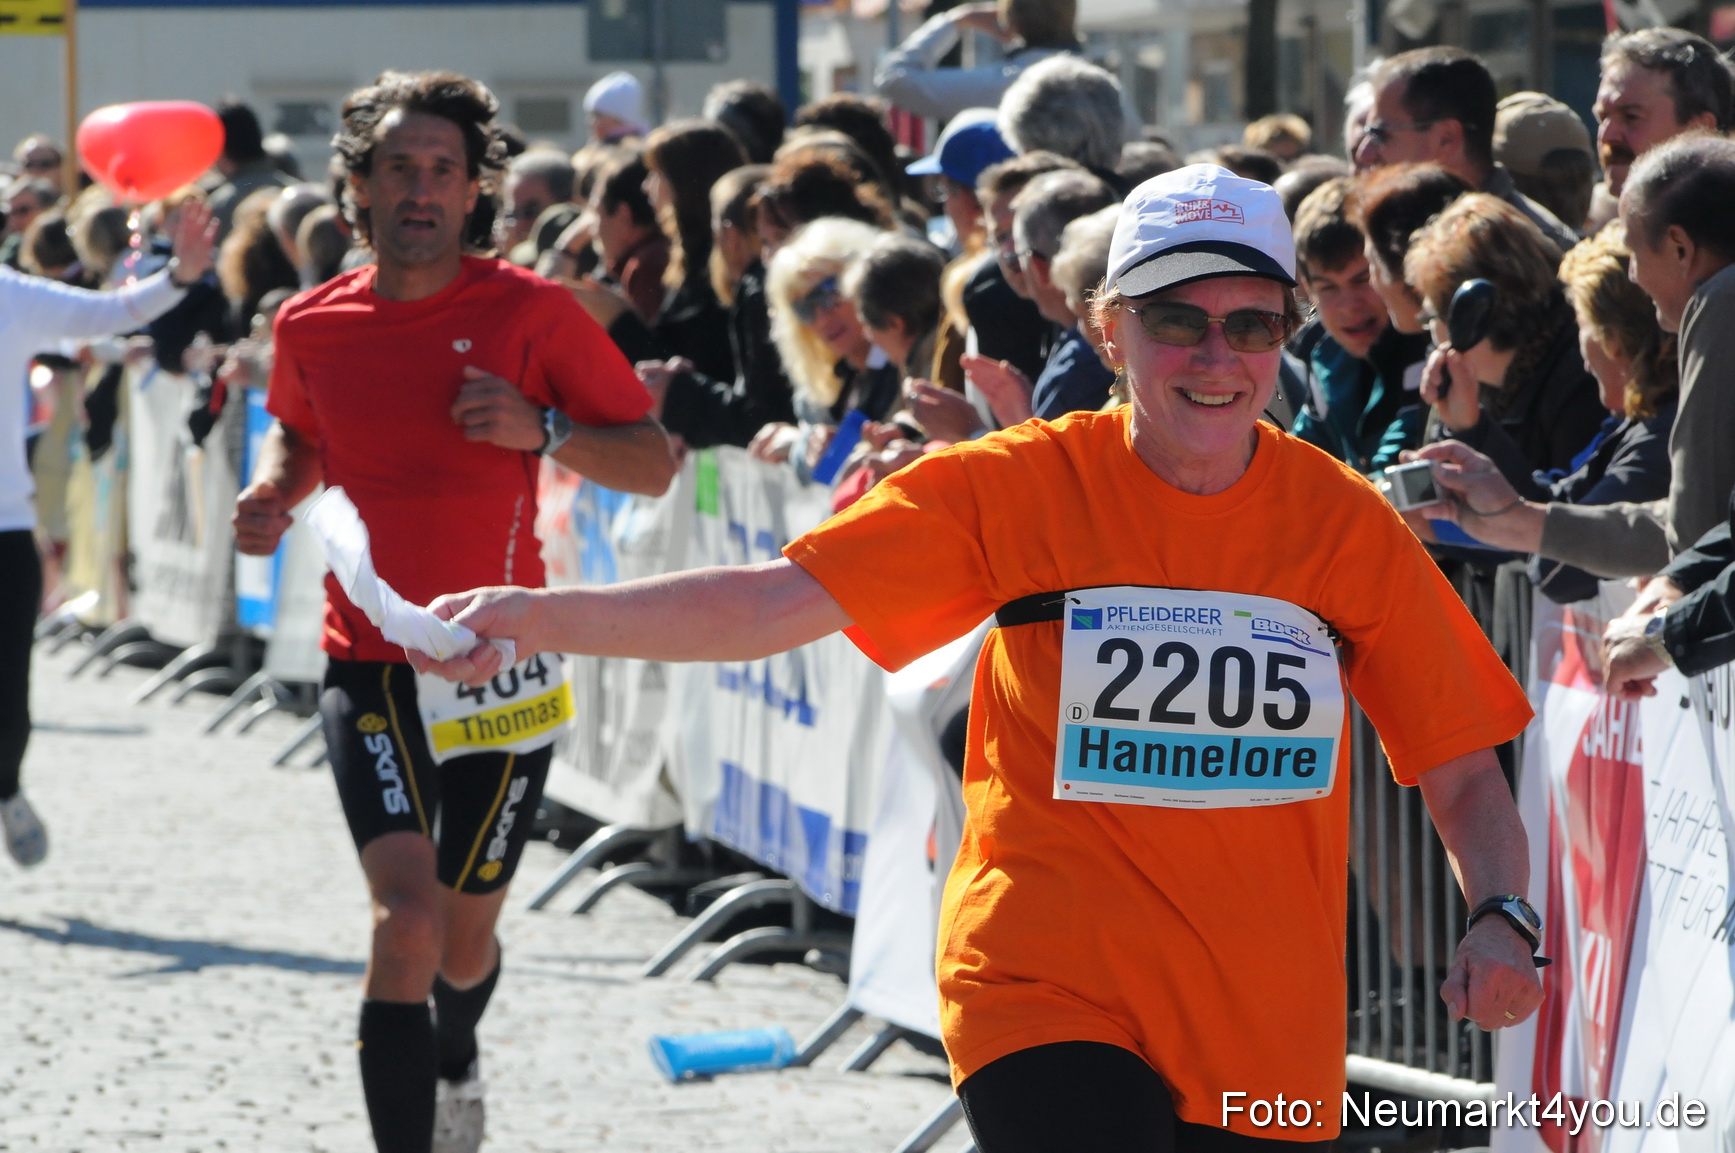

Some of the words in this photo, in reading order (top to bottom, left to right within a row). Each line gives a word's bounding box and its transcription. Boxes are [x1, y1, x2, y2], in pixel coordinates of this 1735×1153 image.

[1176, 209, 1210, 223] MOVE
[1107, 606, 1222, 626] PFLEIDERER
[1107, 624, 1223, 637] AKTIENGESELLSCHAFT
[1252, 618, 1311, 645] BOCK
[1093, 638, 1311, 730] 2205
[458, 697, 561, 742] Thomas
[1072, 706, 1082, 720] D
[1078, 728, 1317, 778] Hannelore
[364, 733, 411, 815] SKINS
